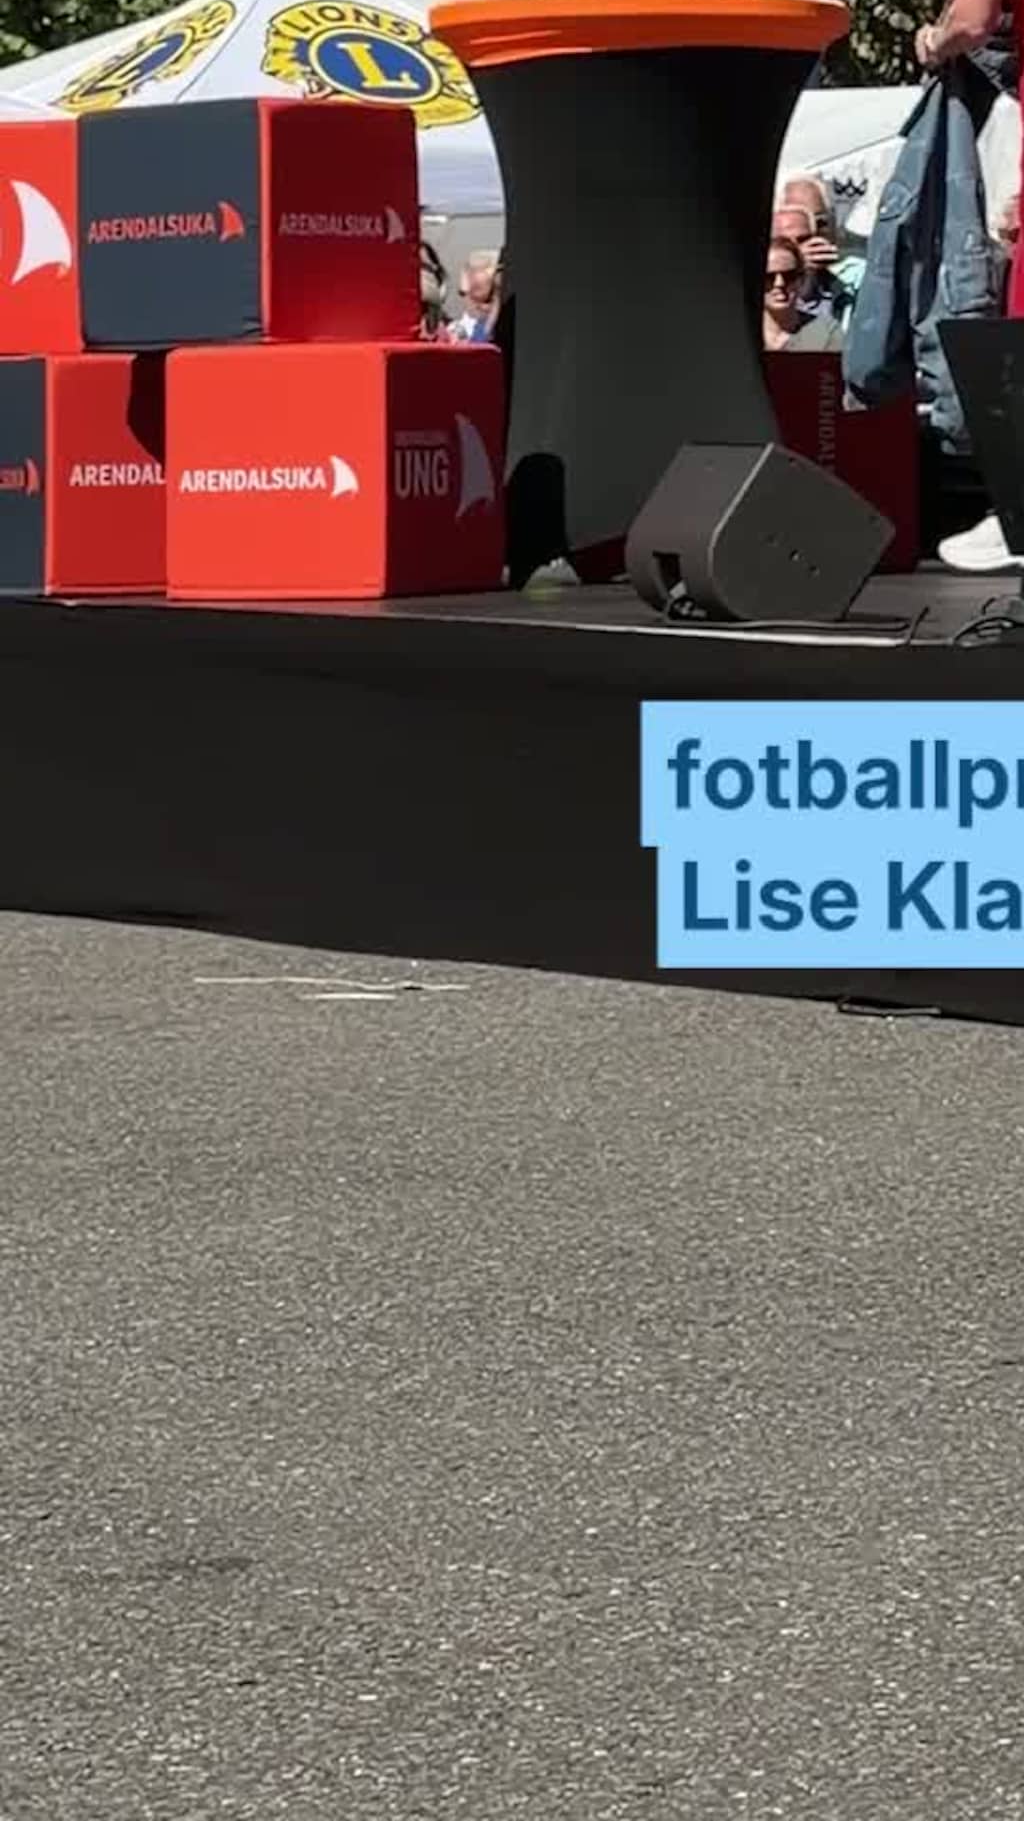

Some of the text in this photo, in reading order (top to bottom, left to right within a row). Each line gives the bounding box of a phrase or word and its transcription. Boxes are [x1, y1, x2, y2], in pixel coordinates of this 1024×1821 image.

[286, 6, 421, 38] LIONS
[337, 42, 421, 89] L
[88, 213, 216, 243] ARENDALSUKA
[279, 213, 384, 236] ARENDALSUKA
[70, 463, 166, 486] ARENDAL
[180, 466, 327, 492] ARENDALSUKA
[394, 449, 449, 498] UNG
